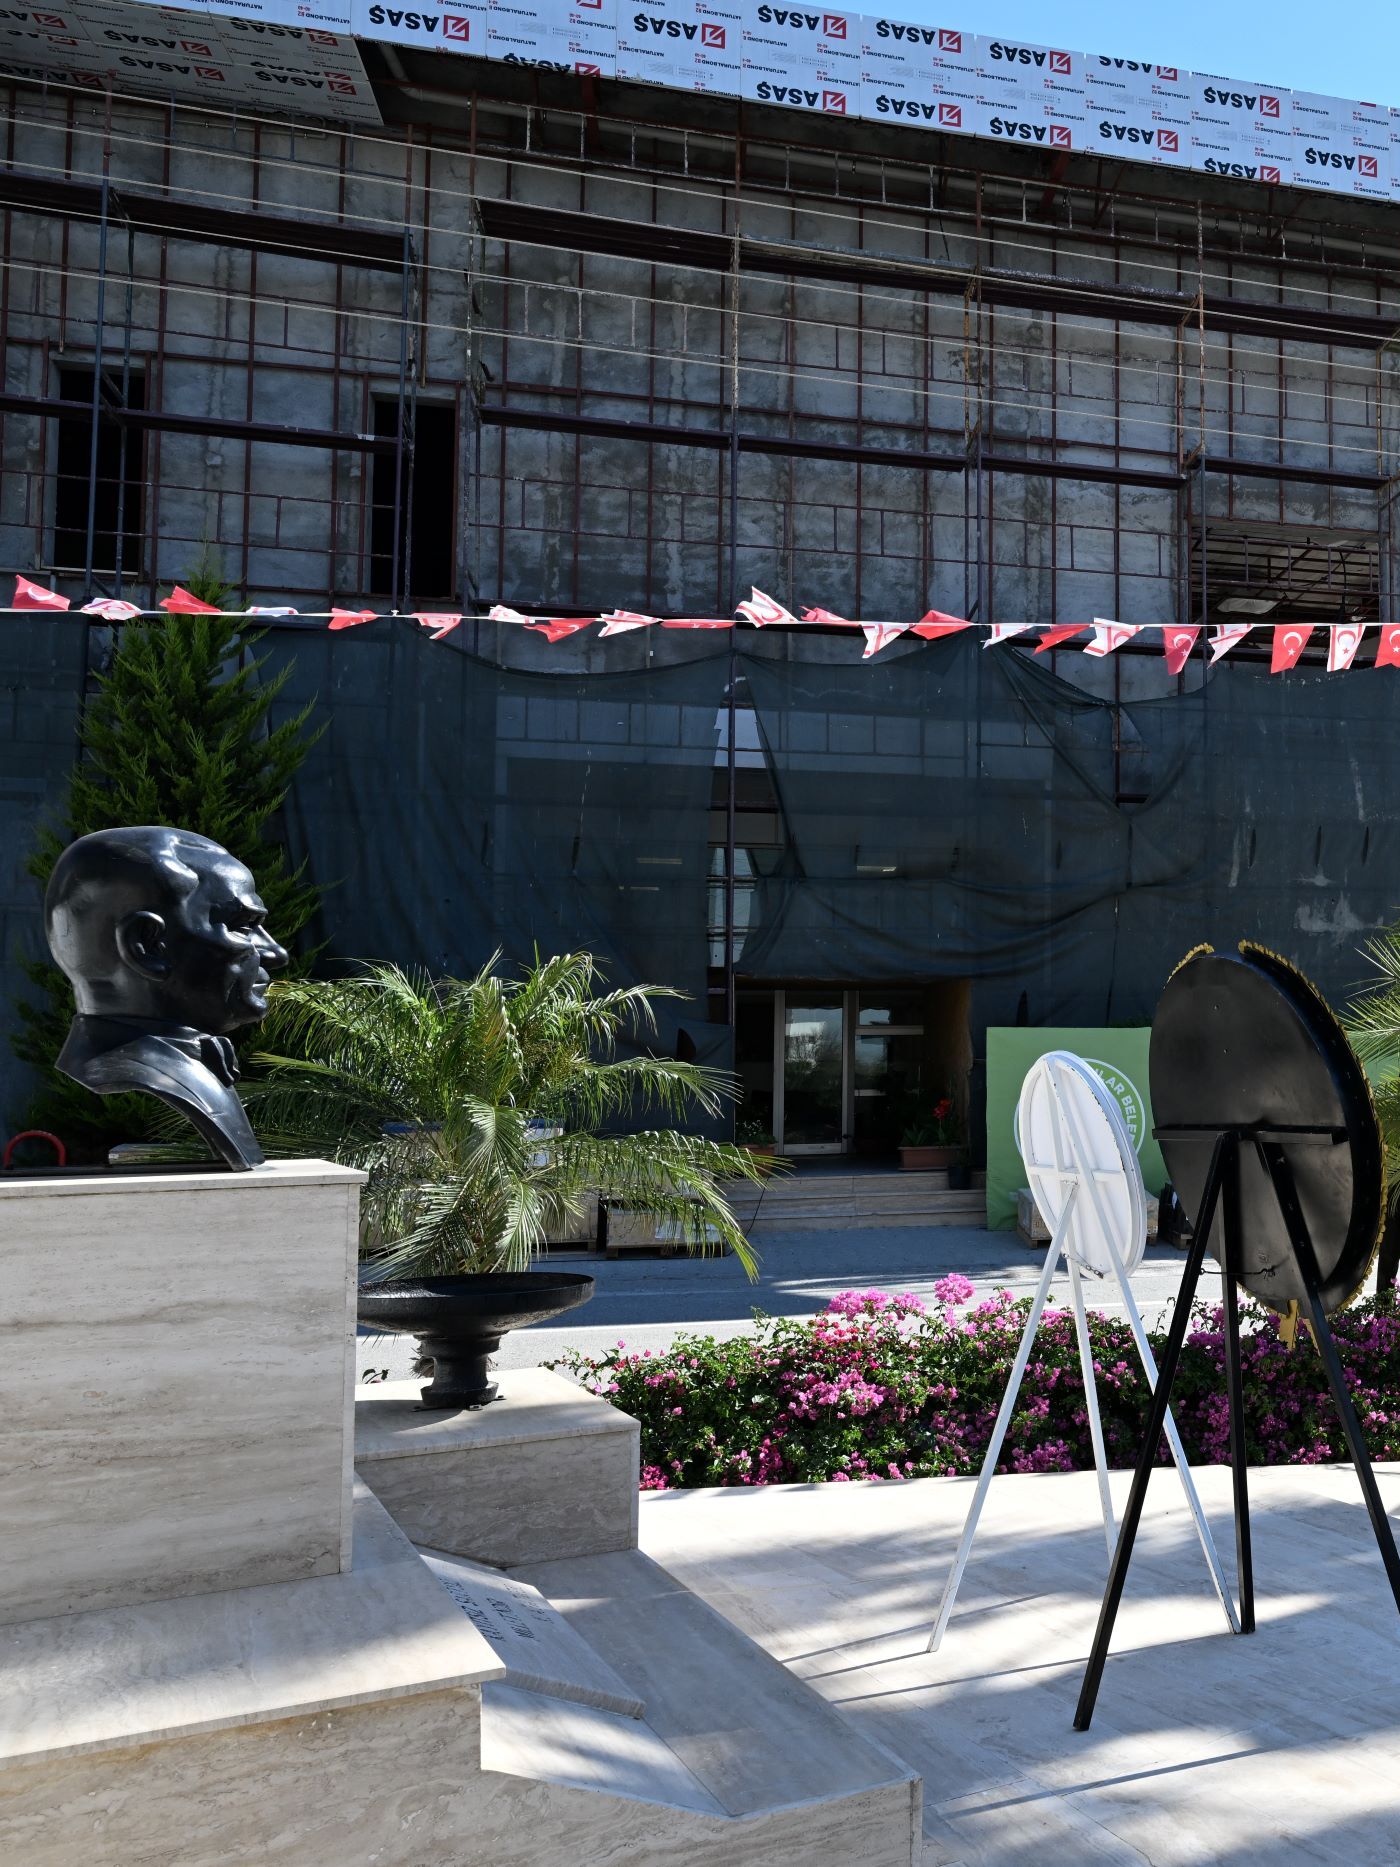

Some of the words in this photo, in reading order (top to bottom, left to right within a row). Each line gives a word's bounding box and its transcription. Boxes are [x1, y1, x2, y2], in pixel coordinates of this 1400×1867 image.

[369, 5, 440, 32] ASAŞ
[634, 13, 698, 40] ASAŞ
[758, 4, 820, 30] ASAŞ
[876, 19, 936, 45] ASAŞ
[990, 42, 1046, 67] ASAŞ
[757, 81, 819, 107] ASAŞ
[1204, 86, 1257, 110] ASAŞ
[876, 94, 936, 120] ASAŞ
[990, 116, 1046, 141] ASAŞ
[1099, 121, 1154, 144] ASAŞ
[1204, 158, 1257, 177] ASAŞ
[1305, 148, 1355, 170] ASAŞ
